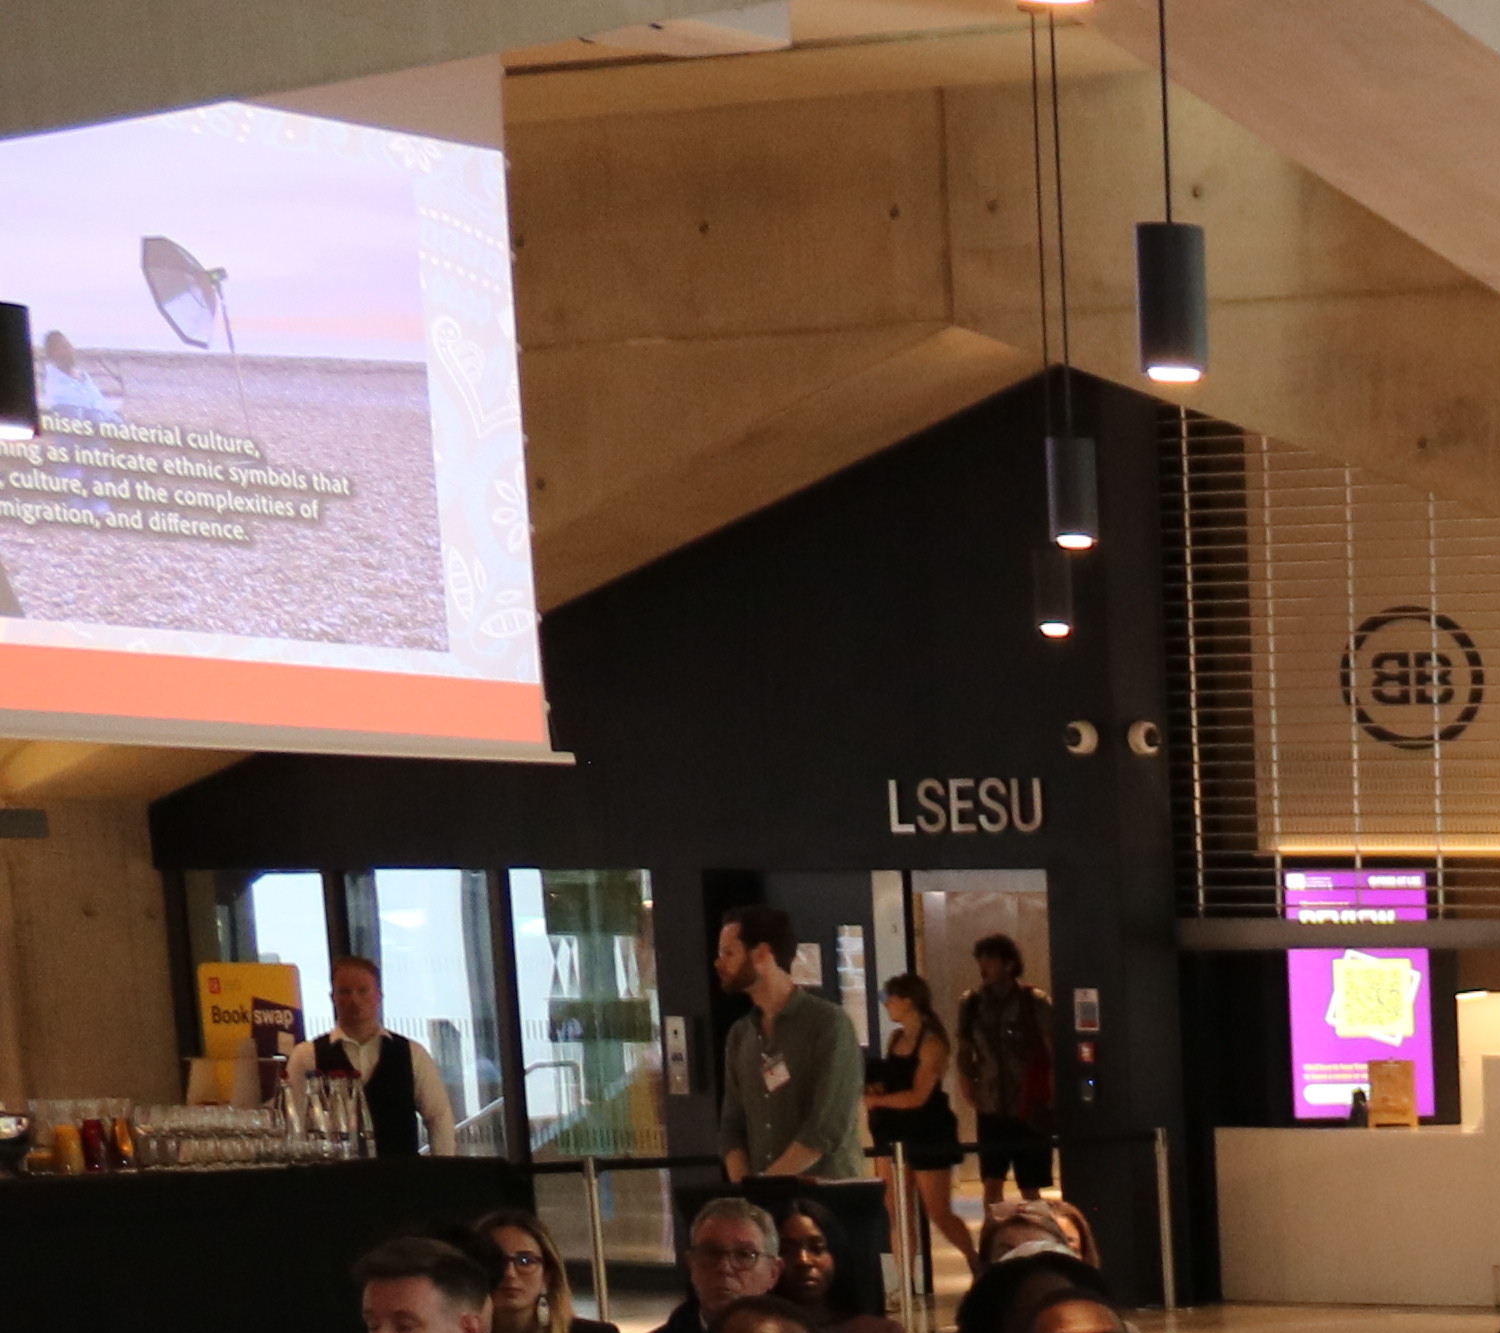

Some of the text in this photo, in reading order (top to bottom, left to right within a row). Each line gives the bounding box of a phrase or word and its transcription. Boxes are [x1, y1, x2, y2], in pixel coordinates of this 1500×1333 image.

[42, 413, 262, 459] nises material culture,
[47, 446, 70, 464] as
[75, 445, 158, 474] intricate
[163, 456, 225, 481] ethnic
[229, 466, 308, 492] symbols
[312, 472, 351, 496] that
[9, 469, 320, 521] culture, and the complexities of
[105, 509, 144, 531] and
[149, 510, 250, 542] difference.
[888, 777, 1043, 834] LSESU
[211, 1005, 294, 1029] Book swap
